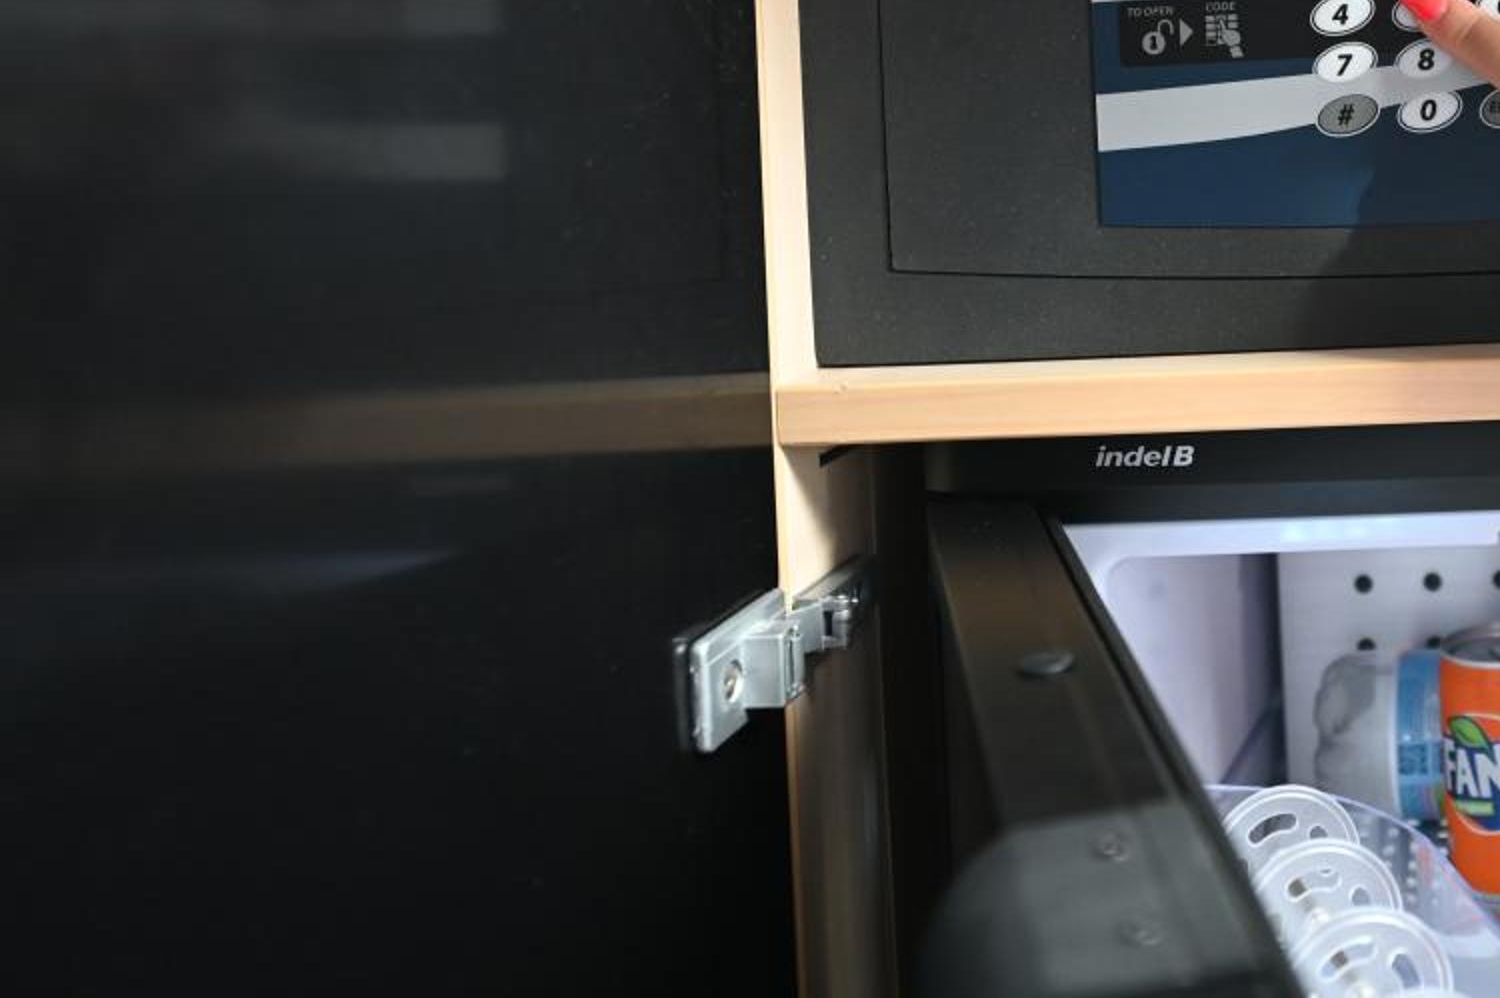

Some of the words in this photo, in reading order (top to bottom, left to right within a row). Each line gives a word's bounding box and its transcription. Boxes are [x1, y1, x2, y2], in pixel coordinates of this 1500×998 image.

[1127, 8, 1142, 18] TO
[1143, 5, 1174, 17] OPEN
[1205, 1, 1237, 12] CODE
[1331, 3, 1349, 25] 4
[1337, 53, 1353, 77] 7
[1417, 48, 1435, 72] 8
[1337, 103, 1355, 126] #
[1419, 98, 1438, 122] 0
